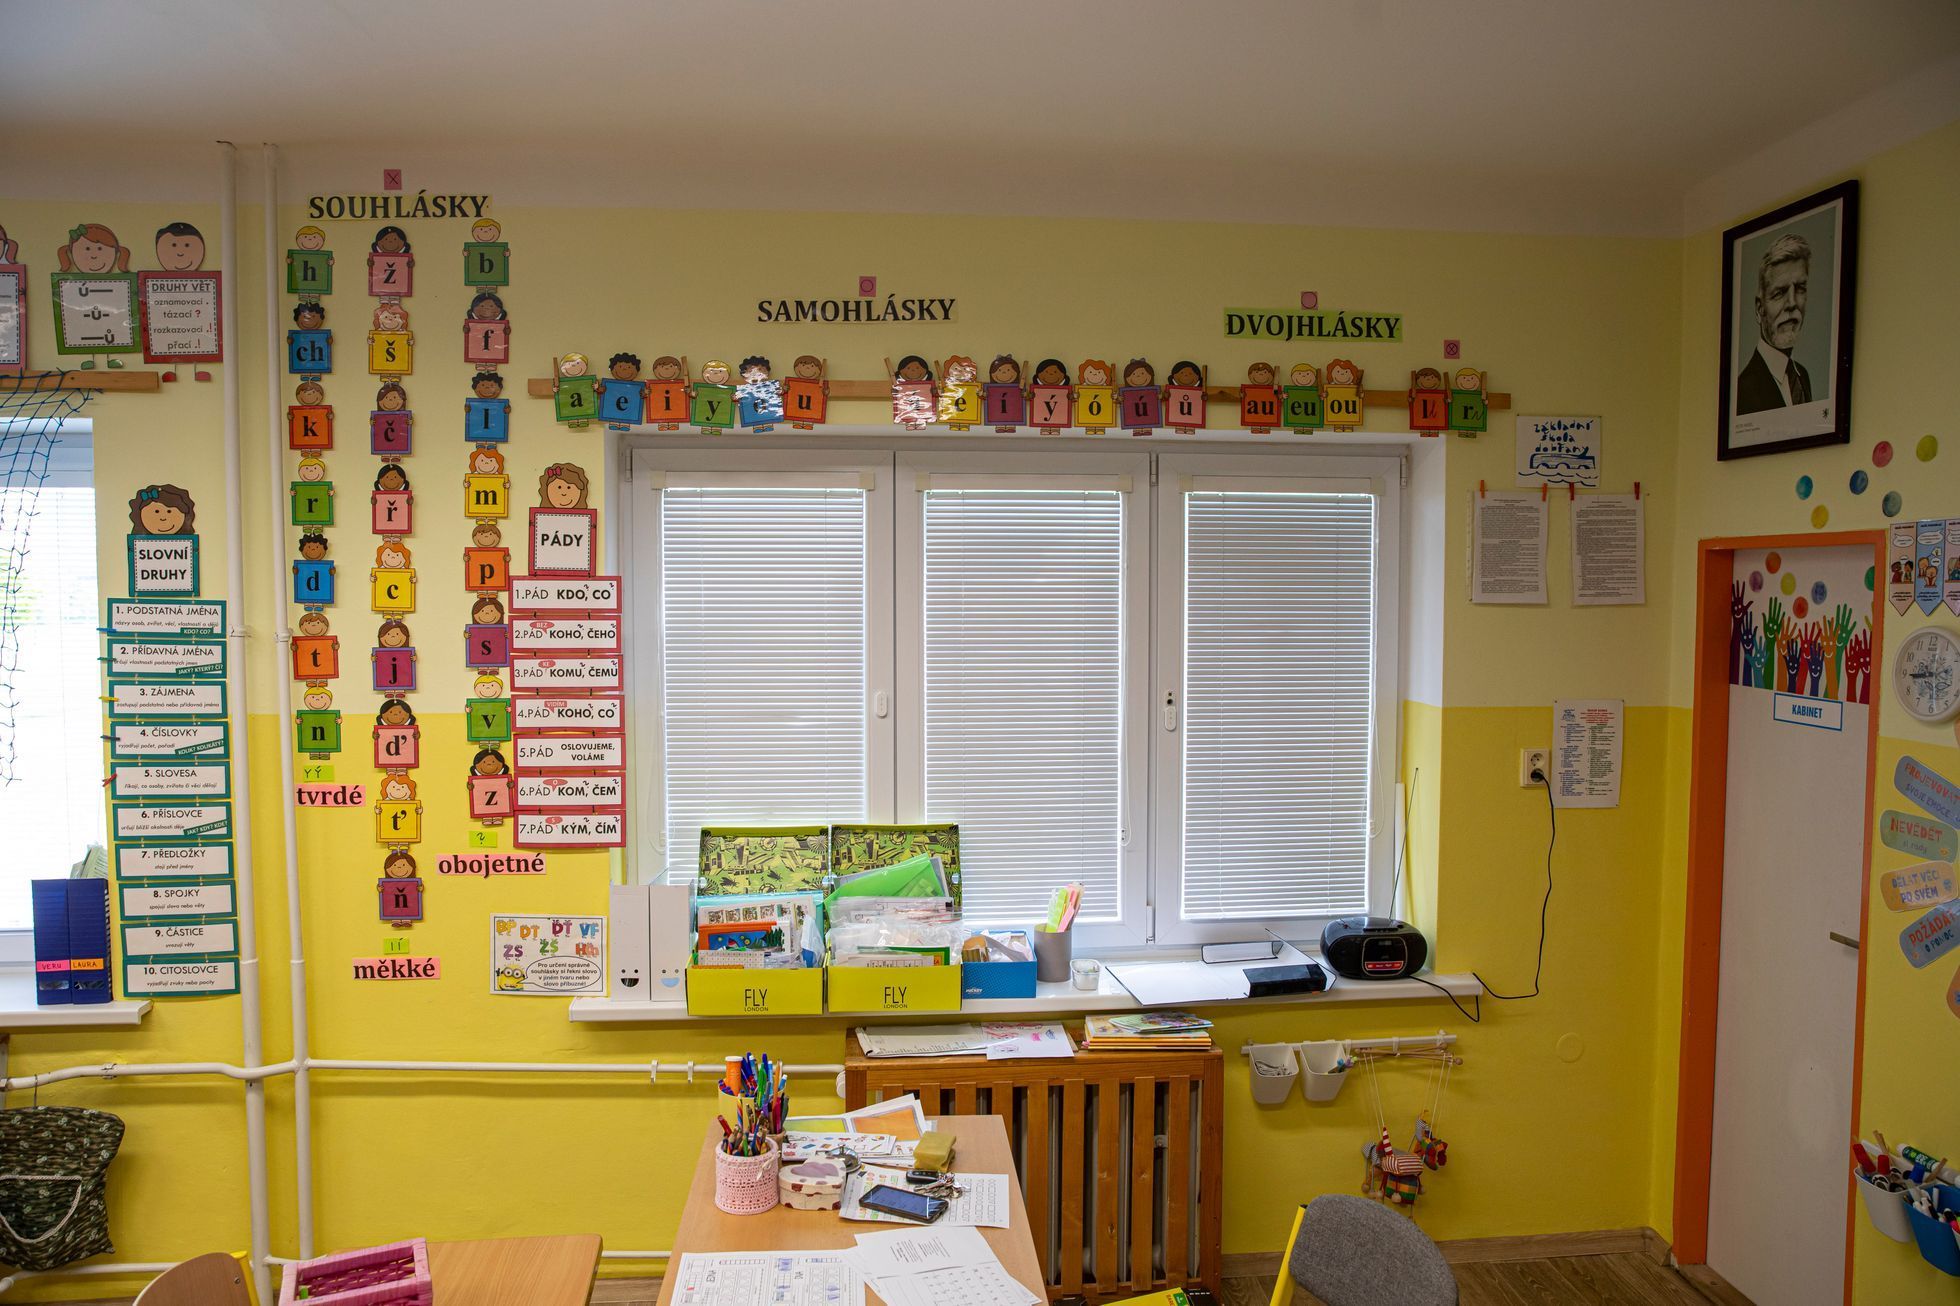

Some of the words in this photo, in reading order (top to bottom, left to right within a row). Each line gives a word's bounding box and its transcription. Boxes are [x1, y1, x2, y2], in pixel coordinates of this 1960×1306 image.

[309, 189, 489, 219] SOUHLÁSKY
[303, 261, 317, 281] h
[479, 253, 494, 274] b
[383, 263, 396, 284] ž
[152, 283, 188, 292] DRUHY
[192, 280, 210, 292] VĚT
[154, 298, 203, 306] oznamovací
[758, 294, 956, 322] SAMOHLÁSKY
[164, 310, 192, 318] tázací
[154, 326, 203, 334] rozkazovací
[1227, 311, 1400, 341] DVOJHLÁSKY
[167, 341, 191, 350] přací
[482, 329, 494, 351] f
[297, 341, 324, 362] ch
[386, 340, 396, 363] š
[570, 392, 584, 408] a
[616, 395, 628, 412] e
[664, 390, 672, 410] i
[798, 394, 812, 410] u
[1001, 393, 1008, 414] í
[1089, 393, 1101, 416] ó
[1135, 395, 1149, 417] ú
[1179, 394, 1193, 415] ů
[1247, 398, 1274, 415] au
[1330, 398, 1358, 414] ou
[706, 400, 721, 421] y
[1044, 395, 1057, 421] ý
[1291, 400, 1316, 417] eu
[303, 416, 318, 437] k
[483, 409, 489, 429] l
[384, 421, 394, 442] č
[475, 490, 498, 505] m
[307, 498, 318, 513] r
[387, 500, 398, 522] ř
[541, 531, 583, 546] PÁDY
[139, 547, 188, 560] SLOVNÍ
[141, 569, 186, 580] DRUHY
[307, 571, 320, 591] d
[480, 563, 494, 584] p
[387, 584, 399, 599] c
[515, 587, 549, 600] 1.PÁD
[557, 589, 589, 601] KDO,
[593, 589, 611, 600] CO
[127, 606, 182, 615] PODSTATNÁ
[187, 606, 219, 616] JMÉNA
[515, 627, 543, 639] 2.PÁD
[550, 630, 584, 640] KOHO,
[588, 627, 615, 639] ČEHO
[1929, 636, 1938, 646] 12
[132, 645, 178, 655] PŘÍDAVNÁ
[183, 646, 214, 656] JMÉNA
[481, 640, 491, 656] s
[1917, 640, 1923, 650] 11
[311, 648, 321, 667] t
[1907, 652, 1914, 662] 10
[389, 658, 397, 684] j
[515, 666, 543, 677] 3.PÁD
[550, 668, 585, 679] KOMU,
[589, 665, 618, 677] ČEMU
[1902, 669, 1907, 679] 9
[151, 687, 195, 696] ZÁJMENA
[1906, 686, 1910, 696] 8
[1916, 697, 1920, 707] 7
[1929, 704, 1933, 713] 6
[1944, 700, 1949, 710] 5
[518, 706, 550, 718] 4.PÁD
[558, 709, 594, 719] KOHO,
[598, 709, 615, 718] CO
[1792, 704, 1822, 719] KABINET
[481, 715, 496, 729] v
[152, 727, 198, 737] ČÍSLOVKY
[312, 726, 325, 741] n
[519, 745, 553, 757] 5.PÁD
[571, 751, 604, 761] VOLÁME
[297, 785, 363, 805] tvrdé
[519, 784, 550, 796] 6.PÁD
[558, 787, 588, 797] KOM,
[592, 784, 616, 795] ČEM
[485, 791, 498, 806] z
[153, 809, 202, 818] PŘÍSLOVCE
[519, 822, 553, 834] 7.PÁD
[561, 822, 591, 835] KÝM,
[595, 822, 617, 834] ČÍM
[153, 849, 206, 858] PŘEDLOŽKY
[438, 853, 544, 878] obojetné
[153, 890, 161, 898] 8.
[165, 889, 200, 897] SPOJKY
[394, 888, 408, 909] ň
[155, 929, 163, 937] 9.
[166, 927, 204, 937] ČÁSTICE
[144, 967, 157, 975] 10.
[160, 965, 219, 974] CITOSLOVCE
[354, 958, 436, 979] měkké
[744, 988, 768, 1007] FLY
[884, 986, 907, 1004] FLY
